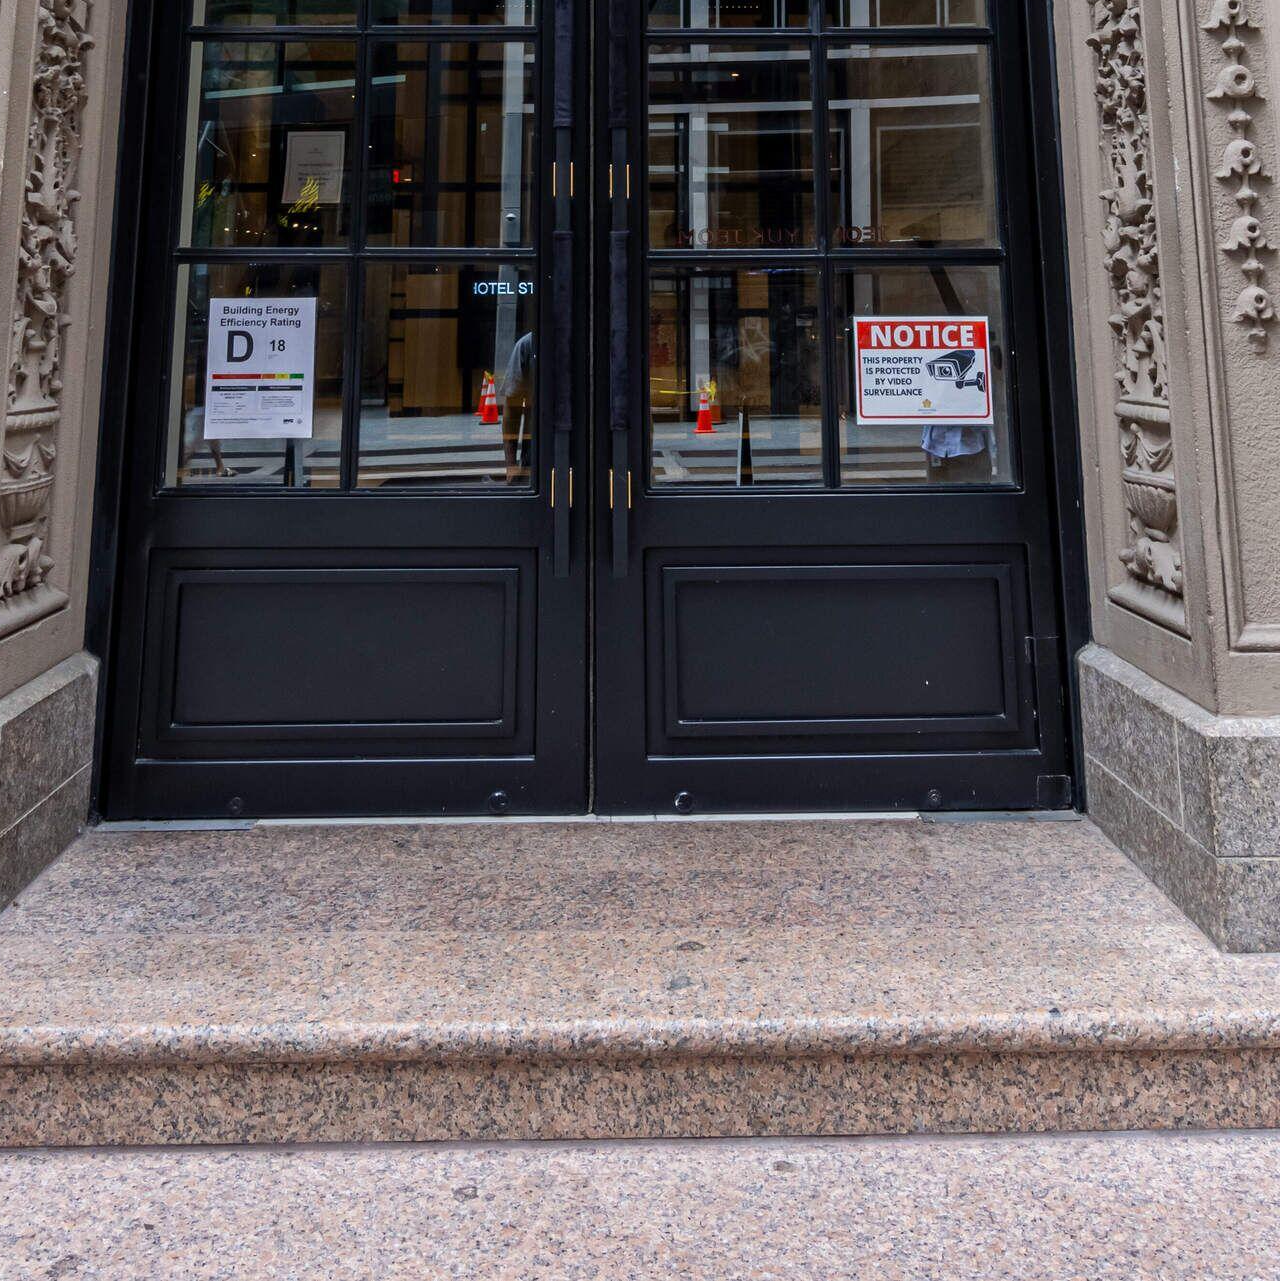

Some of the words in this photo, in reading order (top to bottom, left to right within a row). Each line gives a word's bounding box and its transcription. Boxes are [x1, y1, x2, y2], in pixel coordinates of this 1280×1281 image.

[473, 282, 514, 295] HOTEL
[223, 306, 263, 317] Building
[266, 306, 299, 317] Energy
[220, 318, 267, 328] Efficiency
[270, 318, 301, 328] Rating
[870, 325, 975, 347] NOTICE
[226, 330, 254, 363] D
[269, 339, 286, 352] 18
[862, 356, 880, 364] THIS
[881, 356, 923, 364] PROPERTY
[865, 367, 873, 375] IS
[875, 367, 920, 375] PROTECTED
[875, 378, 886, 386] BY
[888, 378, 912, 386] VIDEO
[863, 388, 922, 396] SURVEILLANCE
